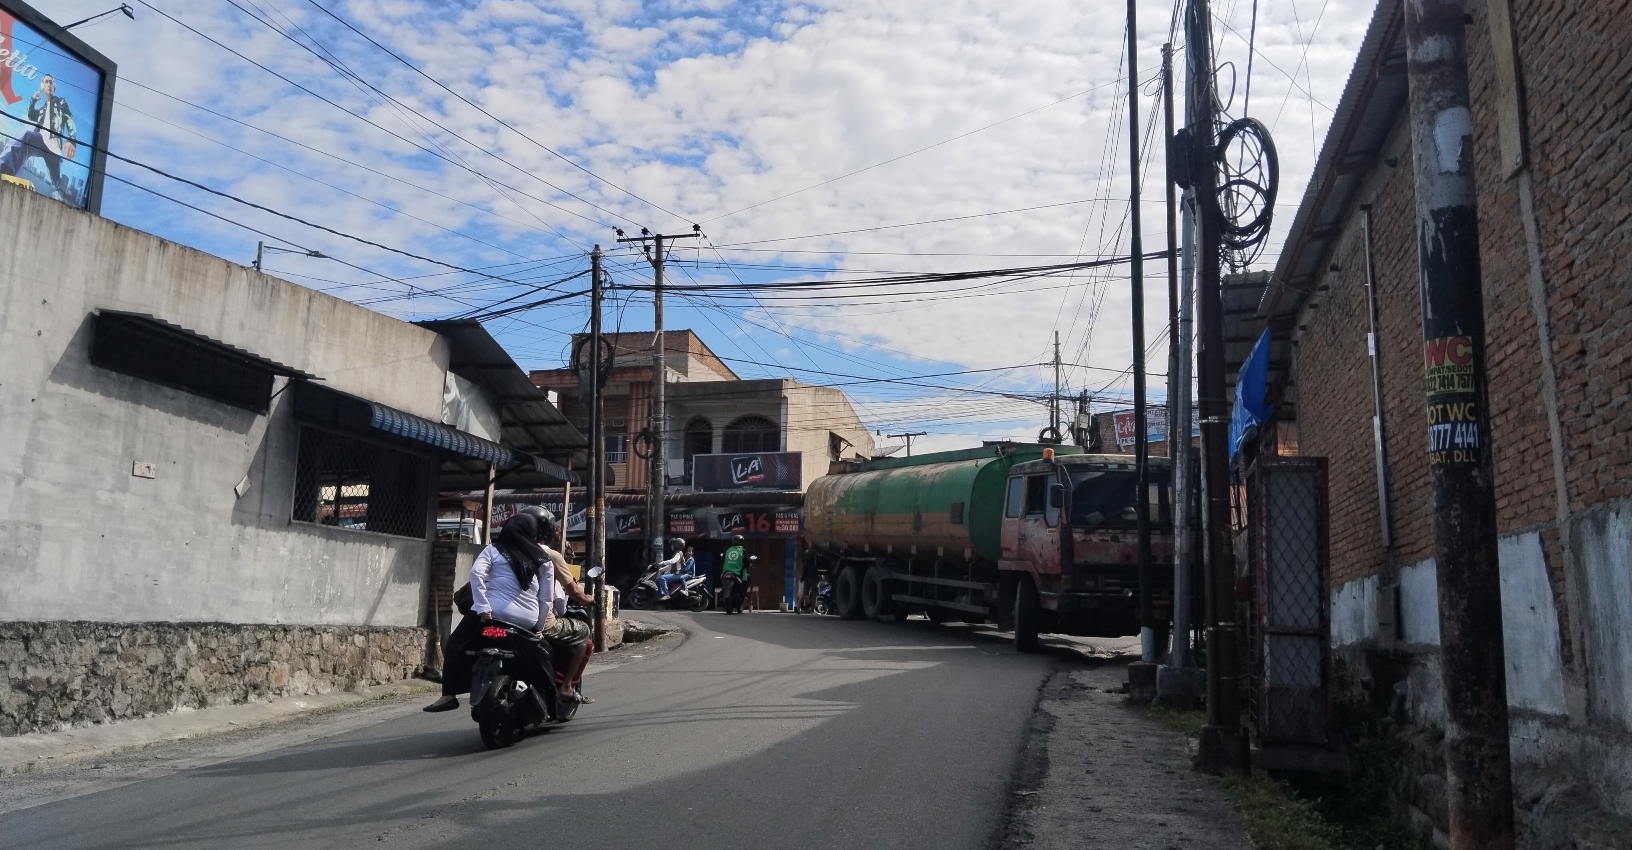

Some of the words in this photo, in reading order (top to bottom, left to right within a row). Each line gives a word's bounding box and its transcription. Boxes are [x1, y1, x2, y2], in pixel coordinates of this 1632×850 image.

[1426, 336, 1472, 368] WC
[1446, 402, 1477, 421] WC
[1455, 422, 1479, 449] 4141
[1454, 449, 1476, 463] DLL
[746, 513, 771, 533] 16
